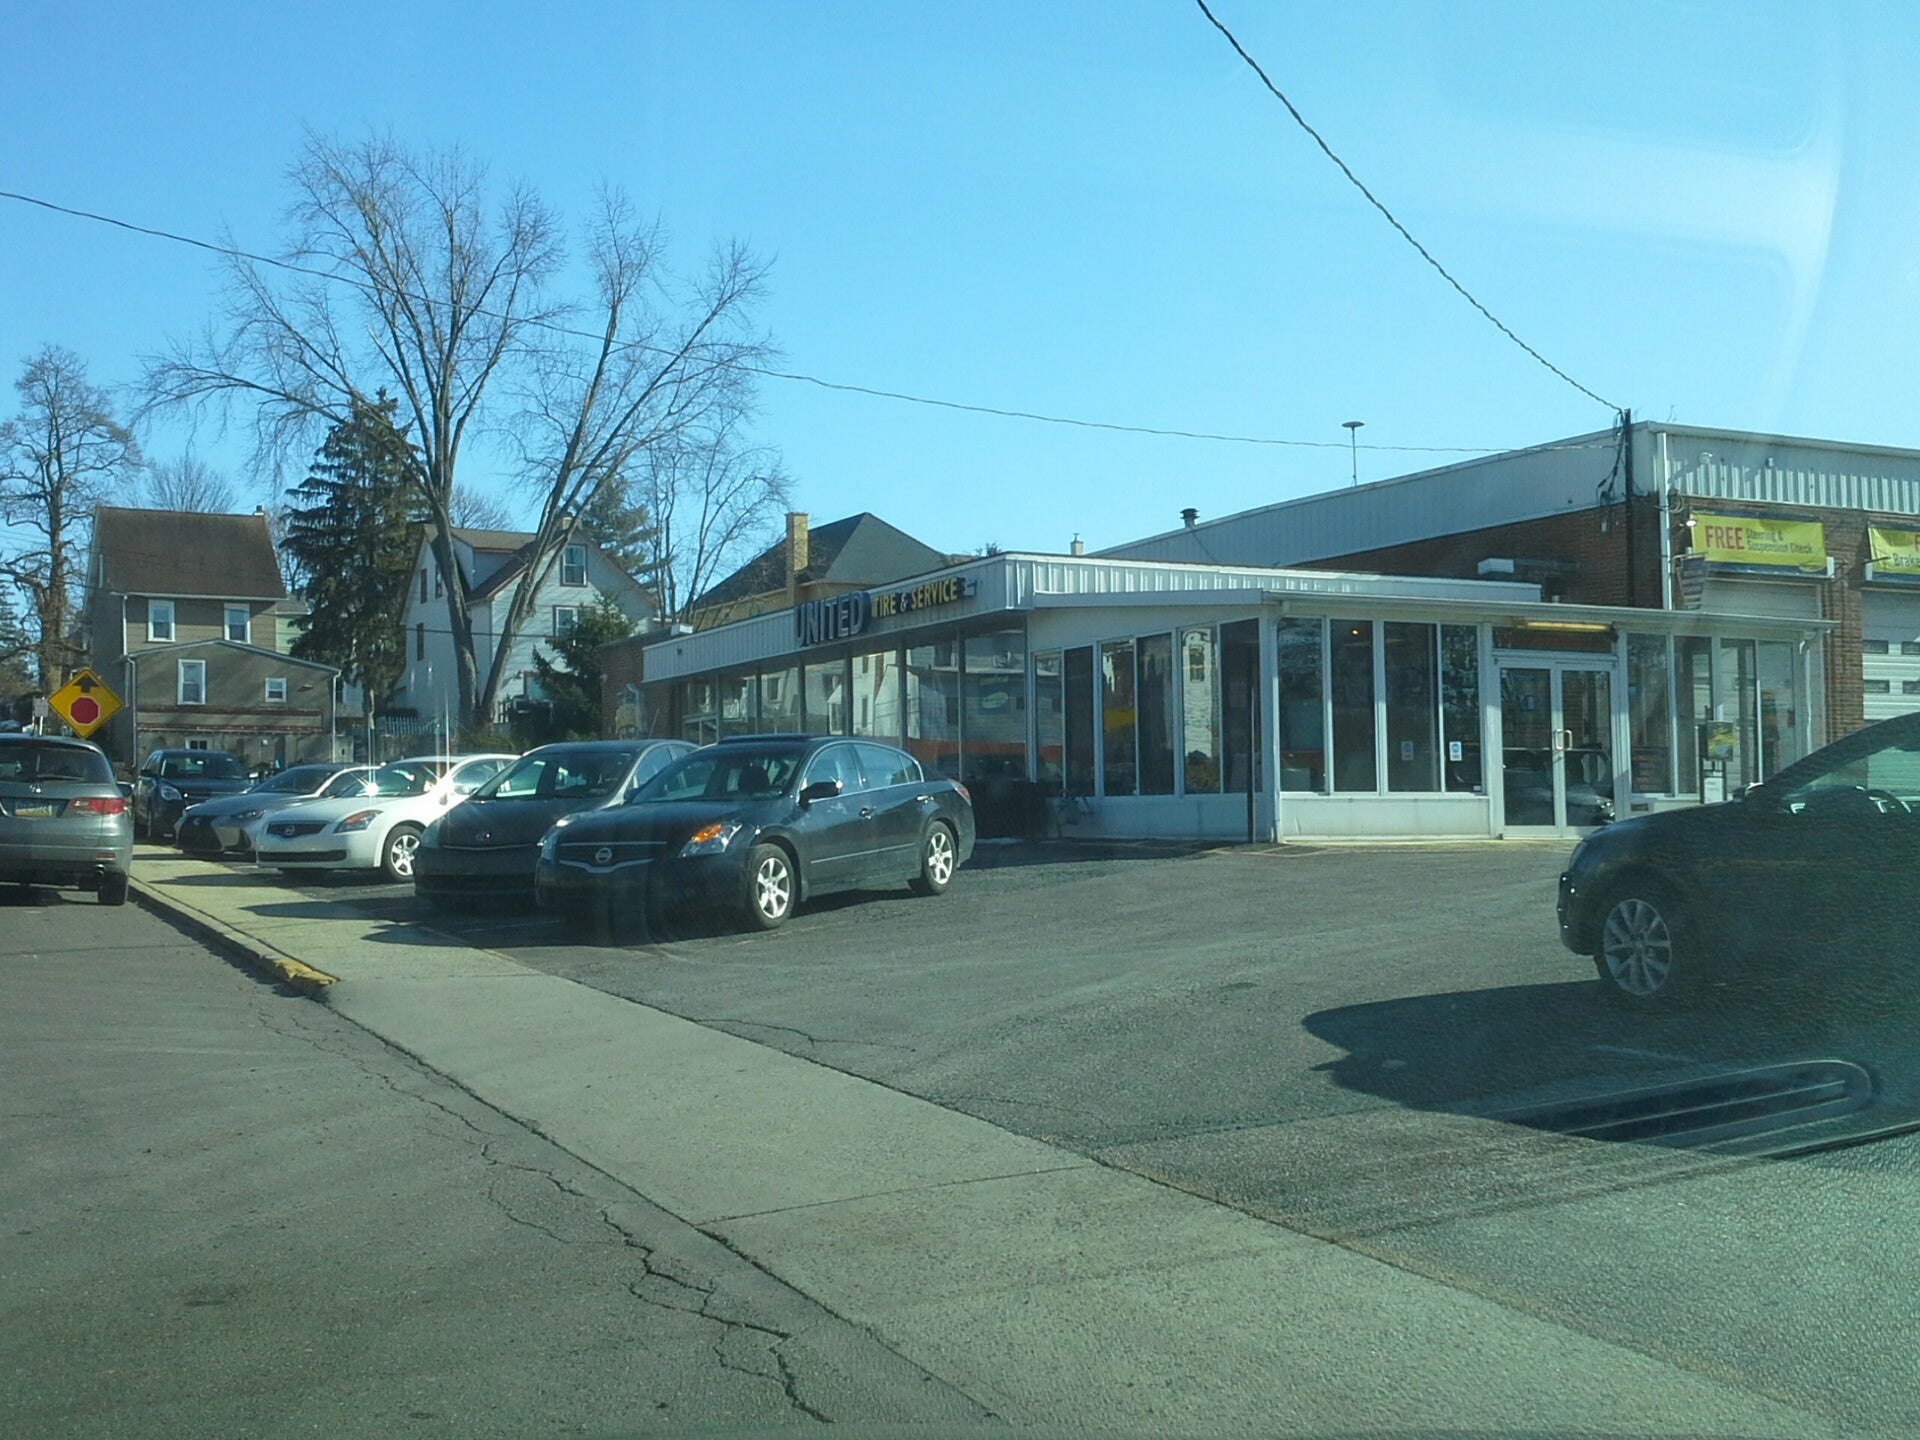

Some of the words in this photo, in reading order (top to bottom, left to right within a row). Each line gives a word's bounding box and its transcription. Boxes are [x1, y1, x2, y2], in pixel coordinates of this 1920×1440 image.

[1705, 525, 1745, 550] FREE
[795, 591, 865, 645] UNITED
[871, 594, 896, 618] TIRE
[899, 592, 909, 613] &
[911, 577, 959, 609] SERVICE
